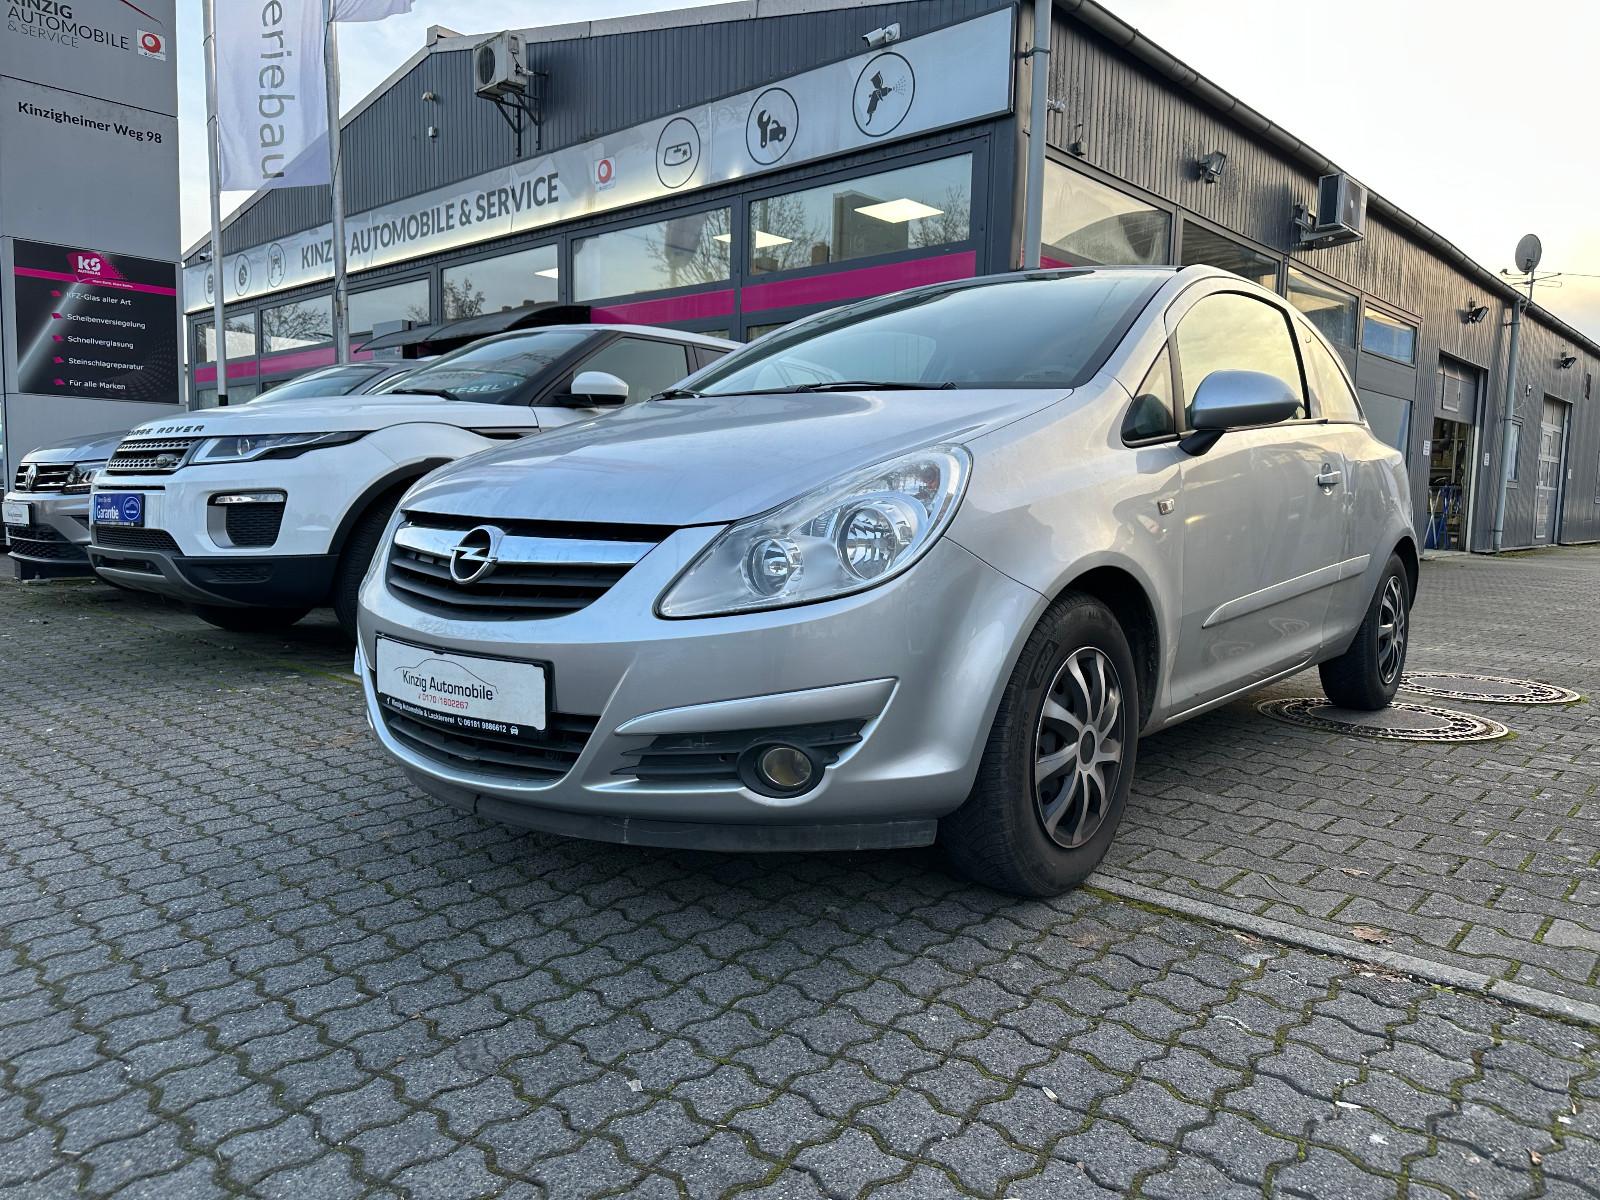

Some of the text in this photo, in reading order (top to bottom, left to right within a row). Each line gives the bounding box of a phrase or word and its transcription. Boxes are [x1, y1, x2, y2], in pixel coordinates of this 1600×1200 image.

[7, 20, 79, 49] & SERVICE
[8, 6, 129, 51] AUTOMOBILE
[18, 101, 162, 144] Kinzigheimer Weg 98
[301, 172, 559, 270] KINZ AUTOMOBILE & SERVICE
[66, 291, 132, 306] KFZ-Glas aller Art
[66, 313, 146, 330] Scheibenversiegelung
[67, 335, 134, 350] Schnellverglasung
[68, 357, 145, 371] Steinschlagreparatur
[69, 379, 126, 390] Für alle Marken
[156, 424, 205, 435] ROVER
[96, 504, 119, 520] Garantie
[402, 669, 494, 701] Kinzig Automobile
